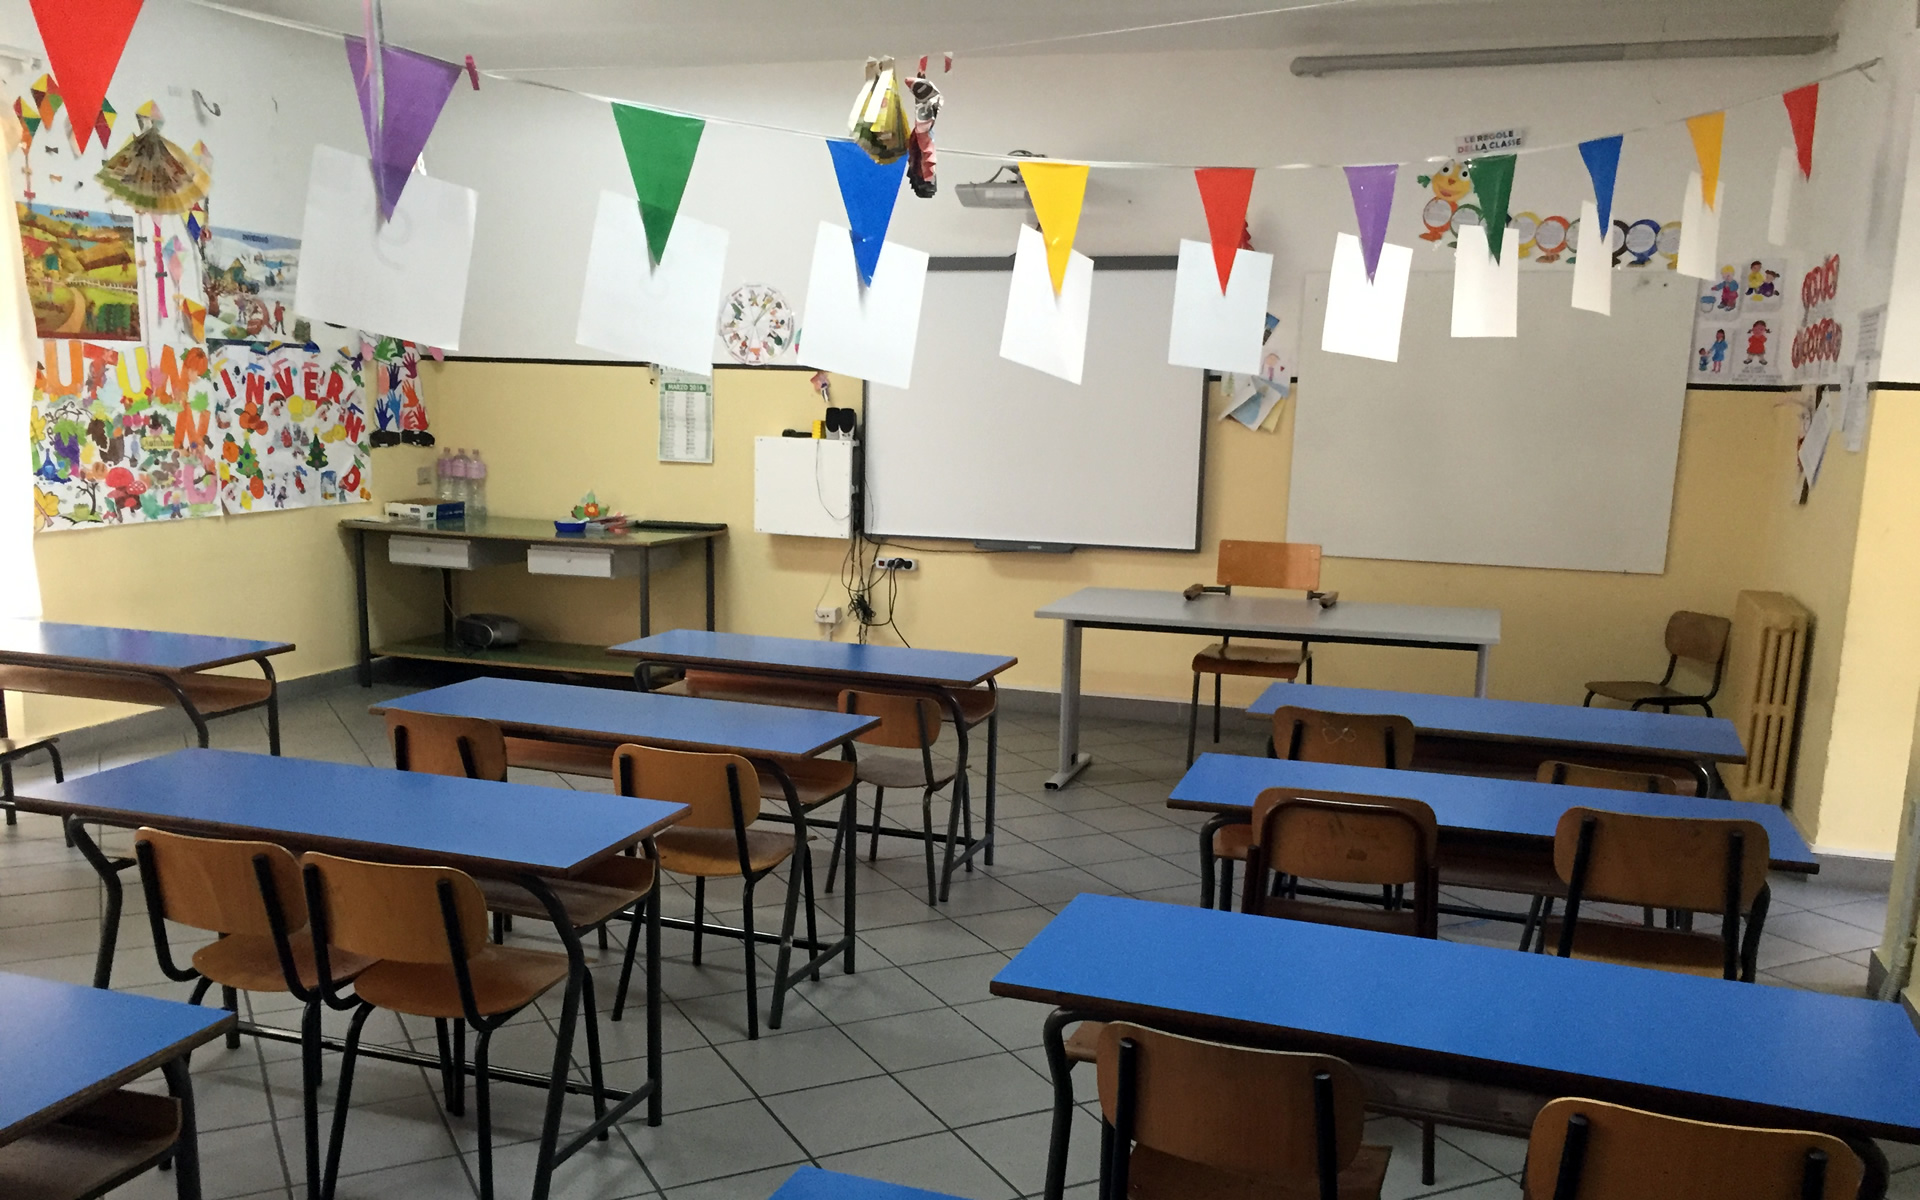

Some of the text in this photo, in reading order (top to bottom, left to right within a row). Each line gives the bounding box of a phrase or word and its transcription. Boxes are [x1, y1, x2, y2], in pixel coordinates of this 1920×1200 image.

[1477, 130, 1514, 142] REGOLE
[1457, 137, 1521, 153] DELLA CLASSE
